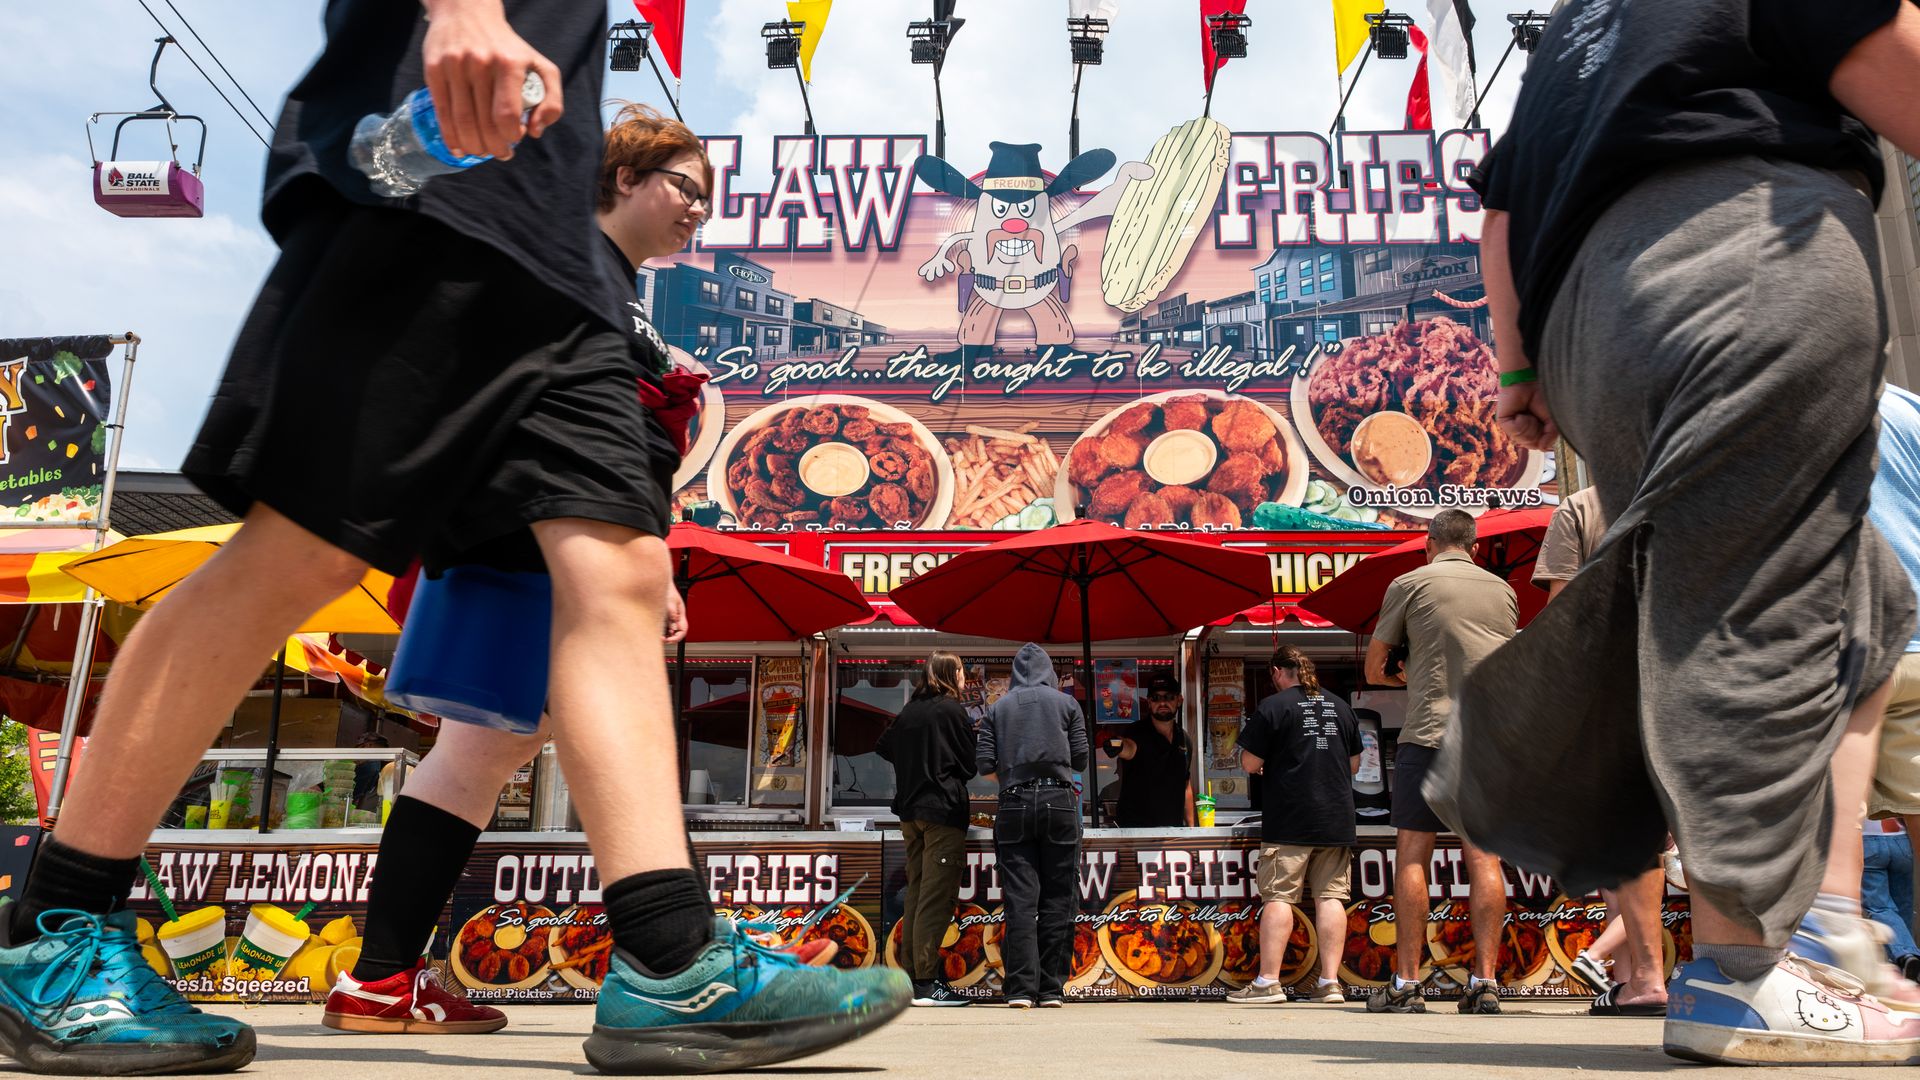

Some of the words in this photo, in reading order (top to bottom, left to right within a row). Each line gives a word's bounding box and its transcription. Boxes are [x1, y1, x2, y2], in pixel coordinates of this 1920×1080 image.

[700, 135, 928, 252] LAW
[1214, 128, 1491, 249] FRIES
[993, 179, 1036, 189] FREUND
[735, 267, 764, 282] HOTEL
[1402, 261, 1468, 284] SALOON
[973, 345, 1088, 393] ought
[1092, 351, 1131, 378] to
[1137, 343, 1170, 377] be
[1349, 486, 1432, 507] Onion
[842, 552, 959, 593] FRES
[494, 855, 603, 904] OUTL
[707, 854, 840, 904] FRIES
[1075, 906, 1137, 930] ought
[1139, 908, 1161, 922] to
[1164, 904, 1184, 922] be
[1189, 905, 1253, 928] illegal
[1519, 904, 1584, 927] ought
[1587, 905, 1607, 920] to
[178, 948, 215, 969] LEMONADE
[241, 943, 275, 965] LEMONADE
[164, 977, 214, 993] resh
[222, 976, 310, 996] Sqeezed
[466, 988, 501, 999] Fried
[504, 988, 553, 999] Pickles
[1069, 986, 1081, 997] &
[1084, 986, 1118, 997] Fries
[1138, 986, 1186, 997] Outlaw
[1190, 985, 1226, 997] Fries
[1520, 985, 1531, 996] &
[1534, 985, 1570, 996] Fries
